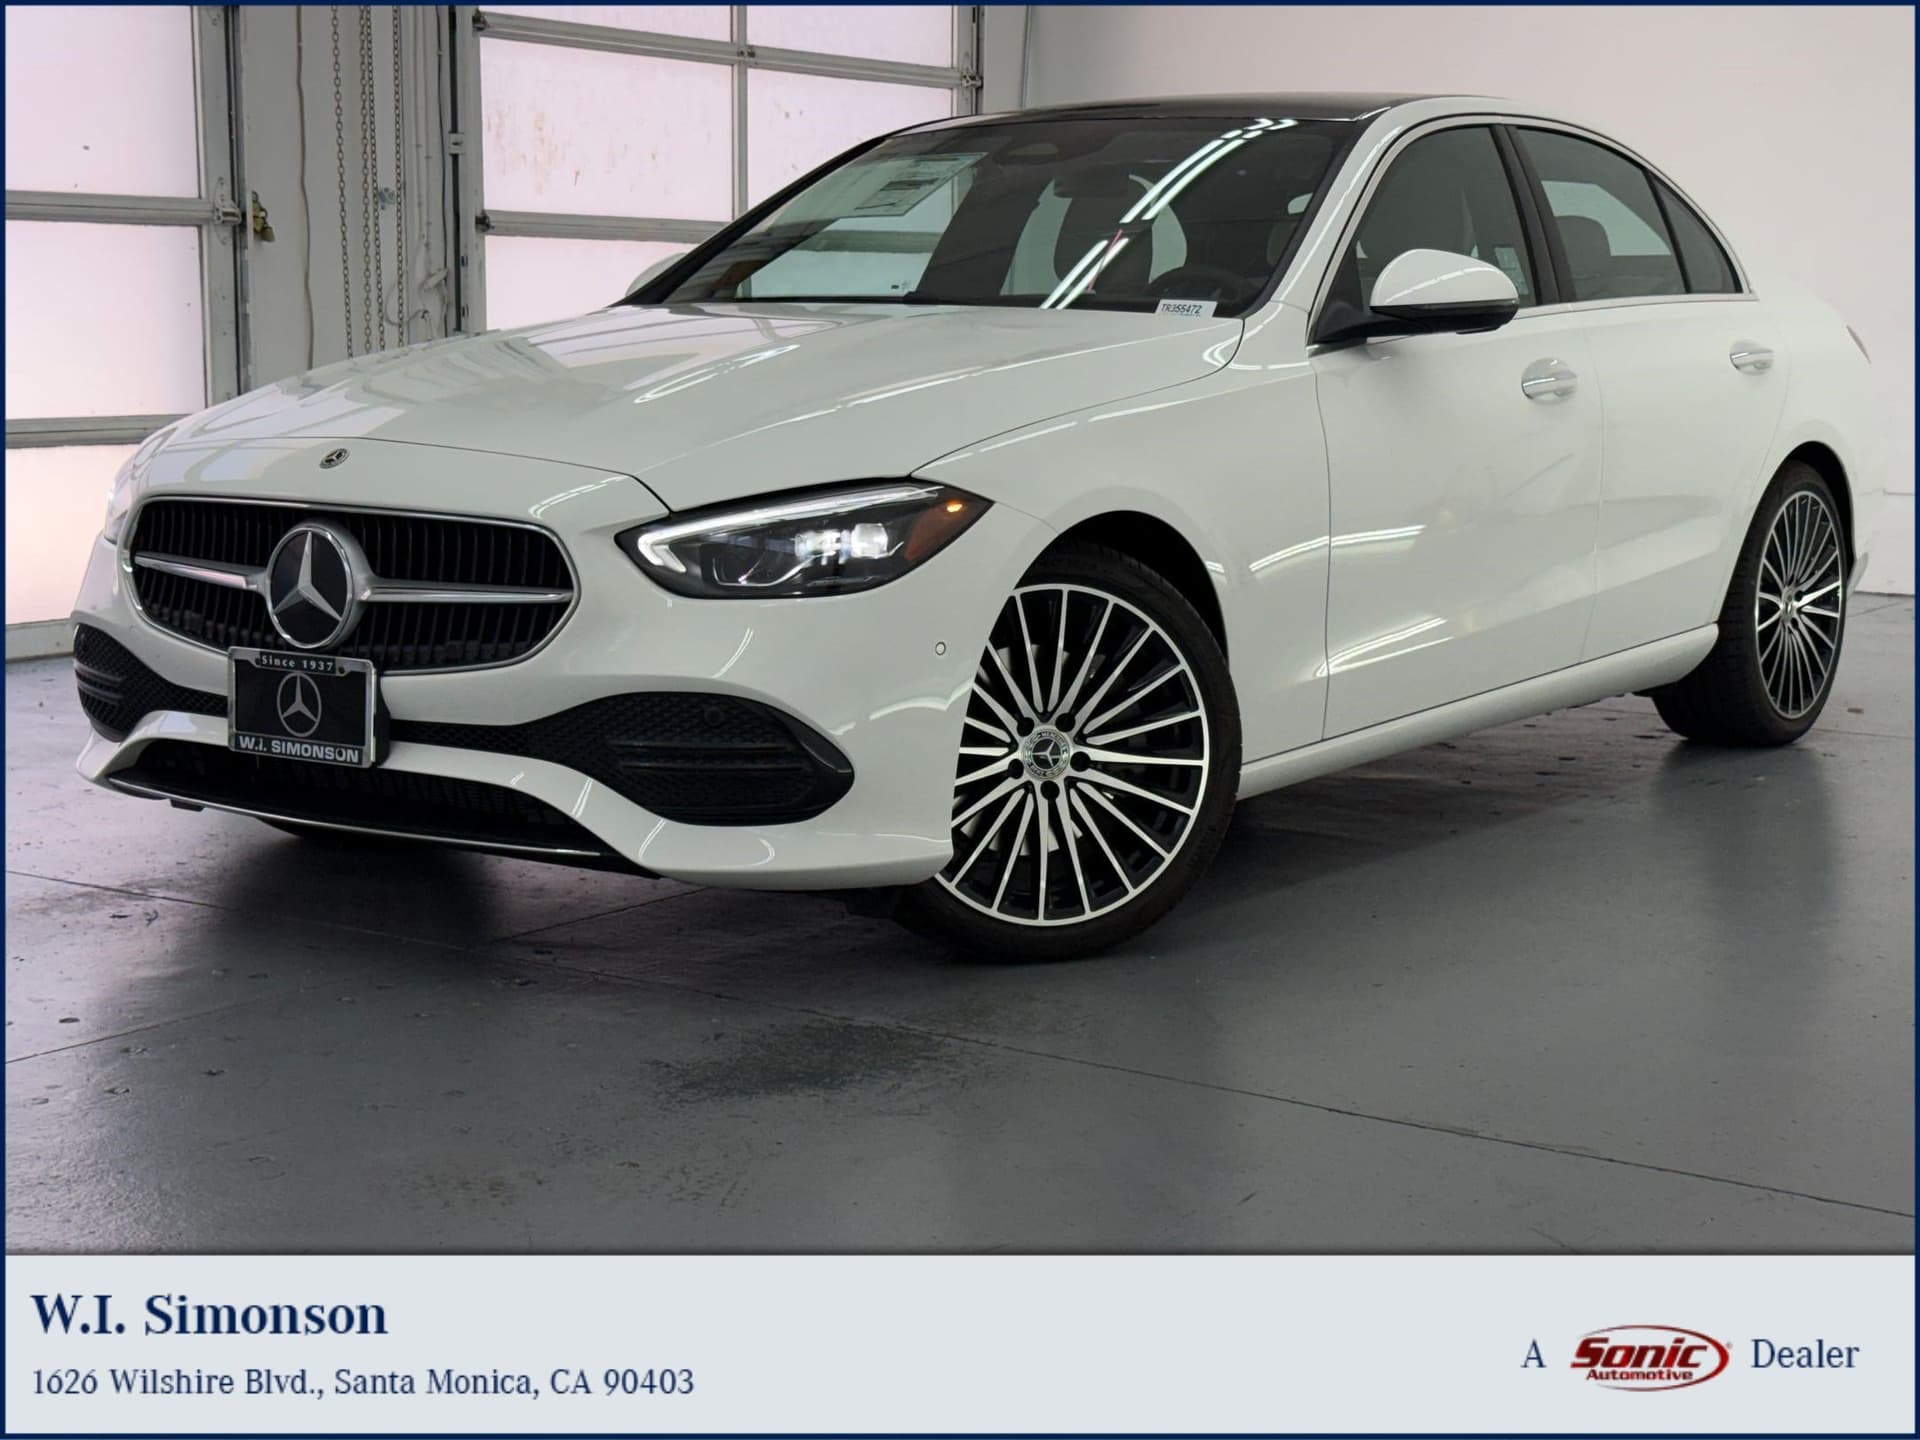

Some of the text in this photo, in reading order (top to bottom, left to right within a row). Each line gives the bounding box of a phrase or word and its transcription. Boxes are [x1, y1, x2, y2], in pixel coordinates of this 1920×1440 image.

[261, 655, 334, 671] Since 1937
[271, 739, 359, 763] SIMONSON
